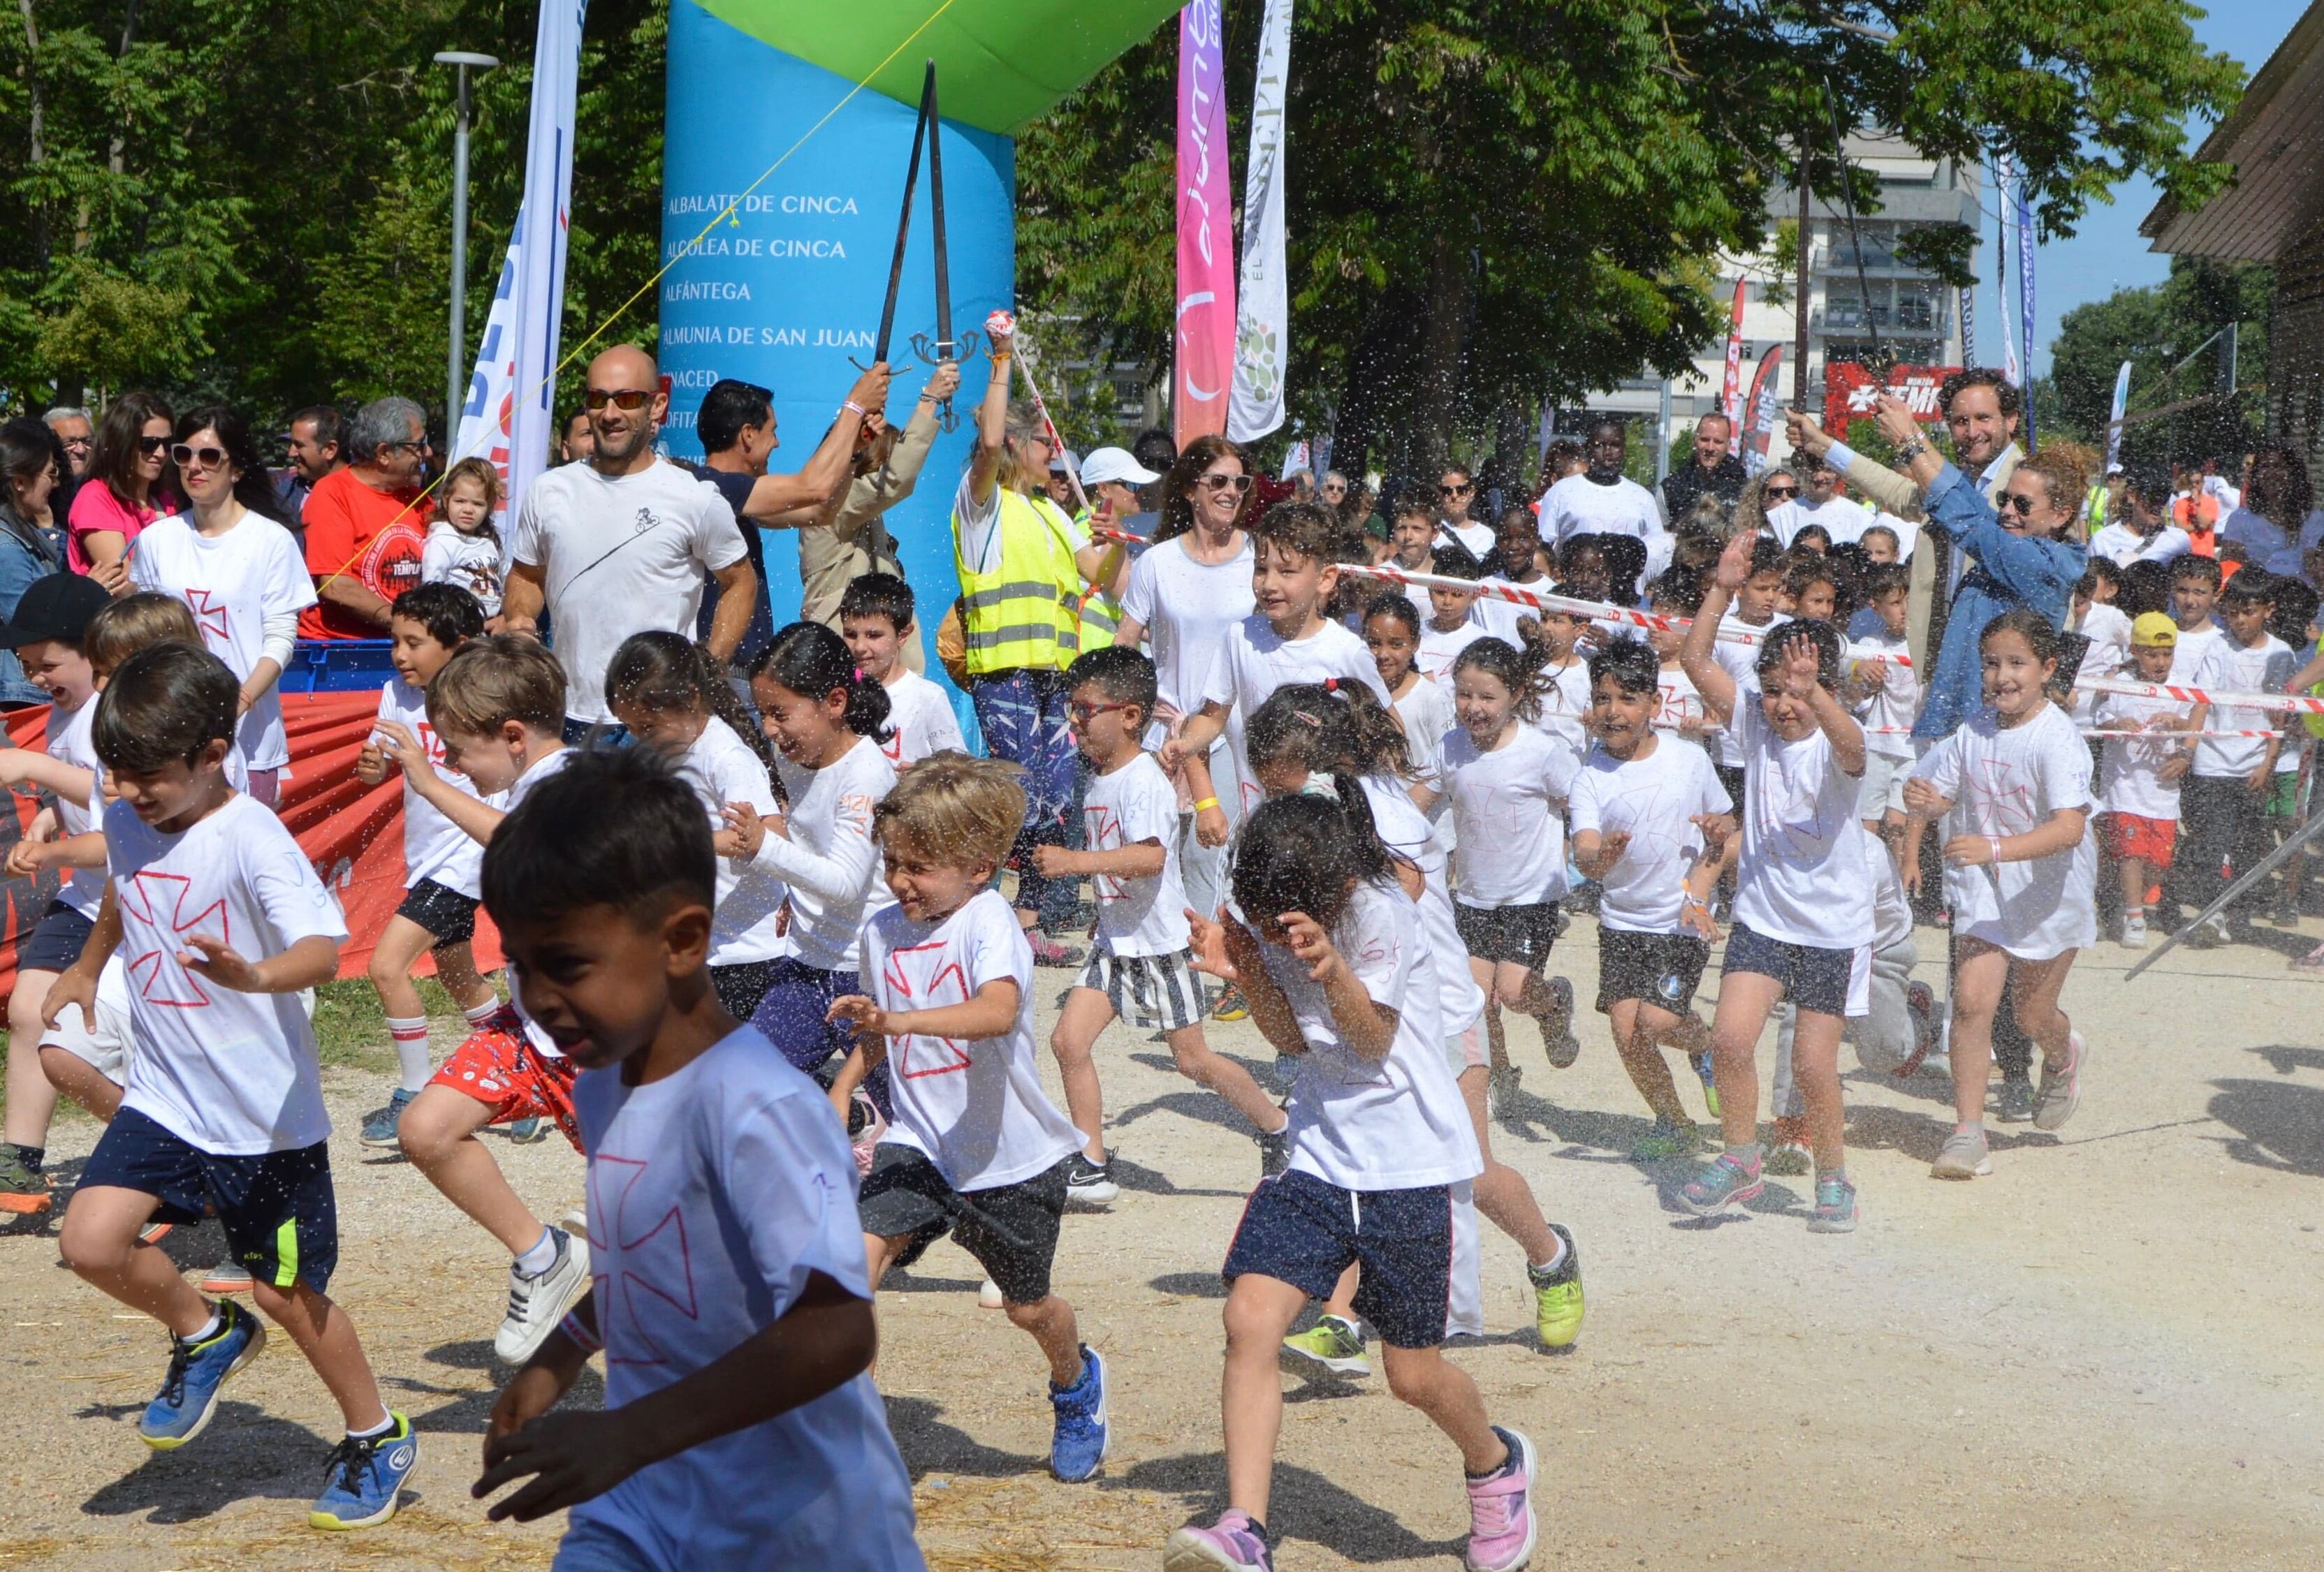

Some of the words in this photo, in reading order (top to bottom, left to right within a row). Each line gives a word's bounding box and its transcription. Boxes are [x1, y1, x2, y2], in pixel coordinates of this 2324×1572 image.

[668, 194, 740, 216] ALBALATE
[745, 195, 775, 213] DE
[781, 195, 858, 215] CINCA
[666, 238, 730, 258] ALCOLEA
[735, 239, 763, 256] DE
[770, 239, 846, 258] CINCA
[1252, 258, 1263, 281] EL
[665, 280, 751, 302] ALFÁNTEGA
[664, 325, 722, 345] ALMUNIA
[727, 327, 755, 344] DE
[761, 328, 806, 346] SAN
[812, 328, 876, 348] JUAN
[1757, 385, 1778, 433] RACE
[312, 883, 326, 908] 3
